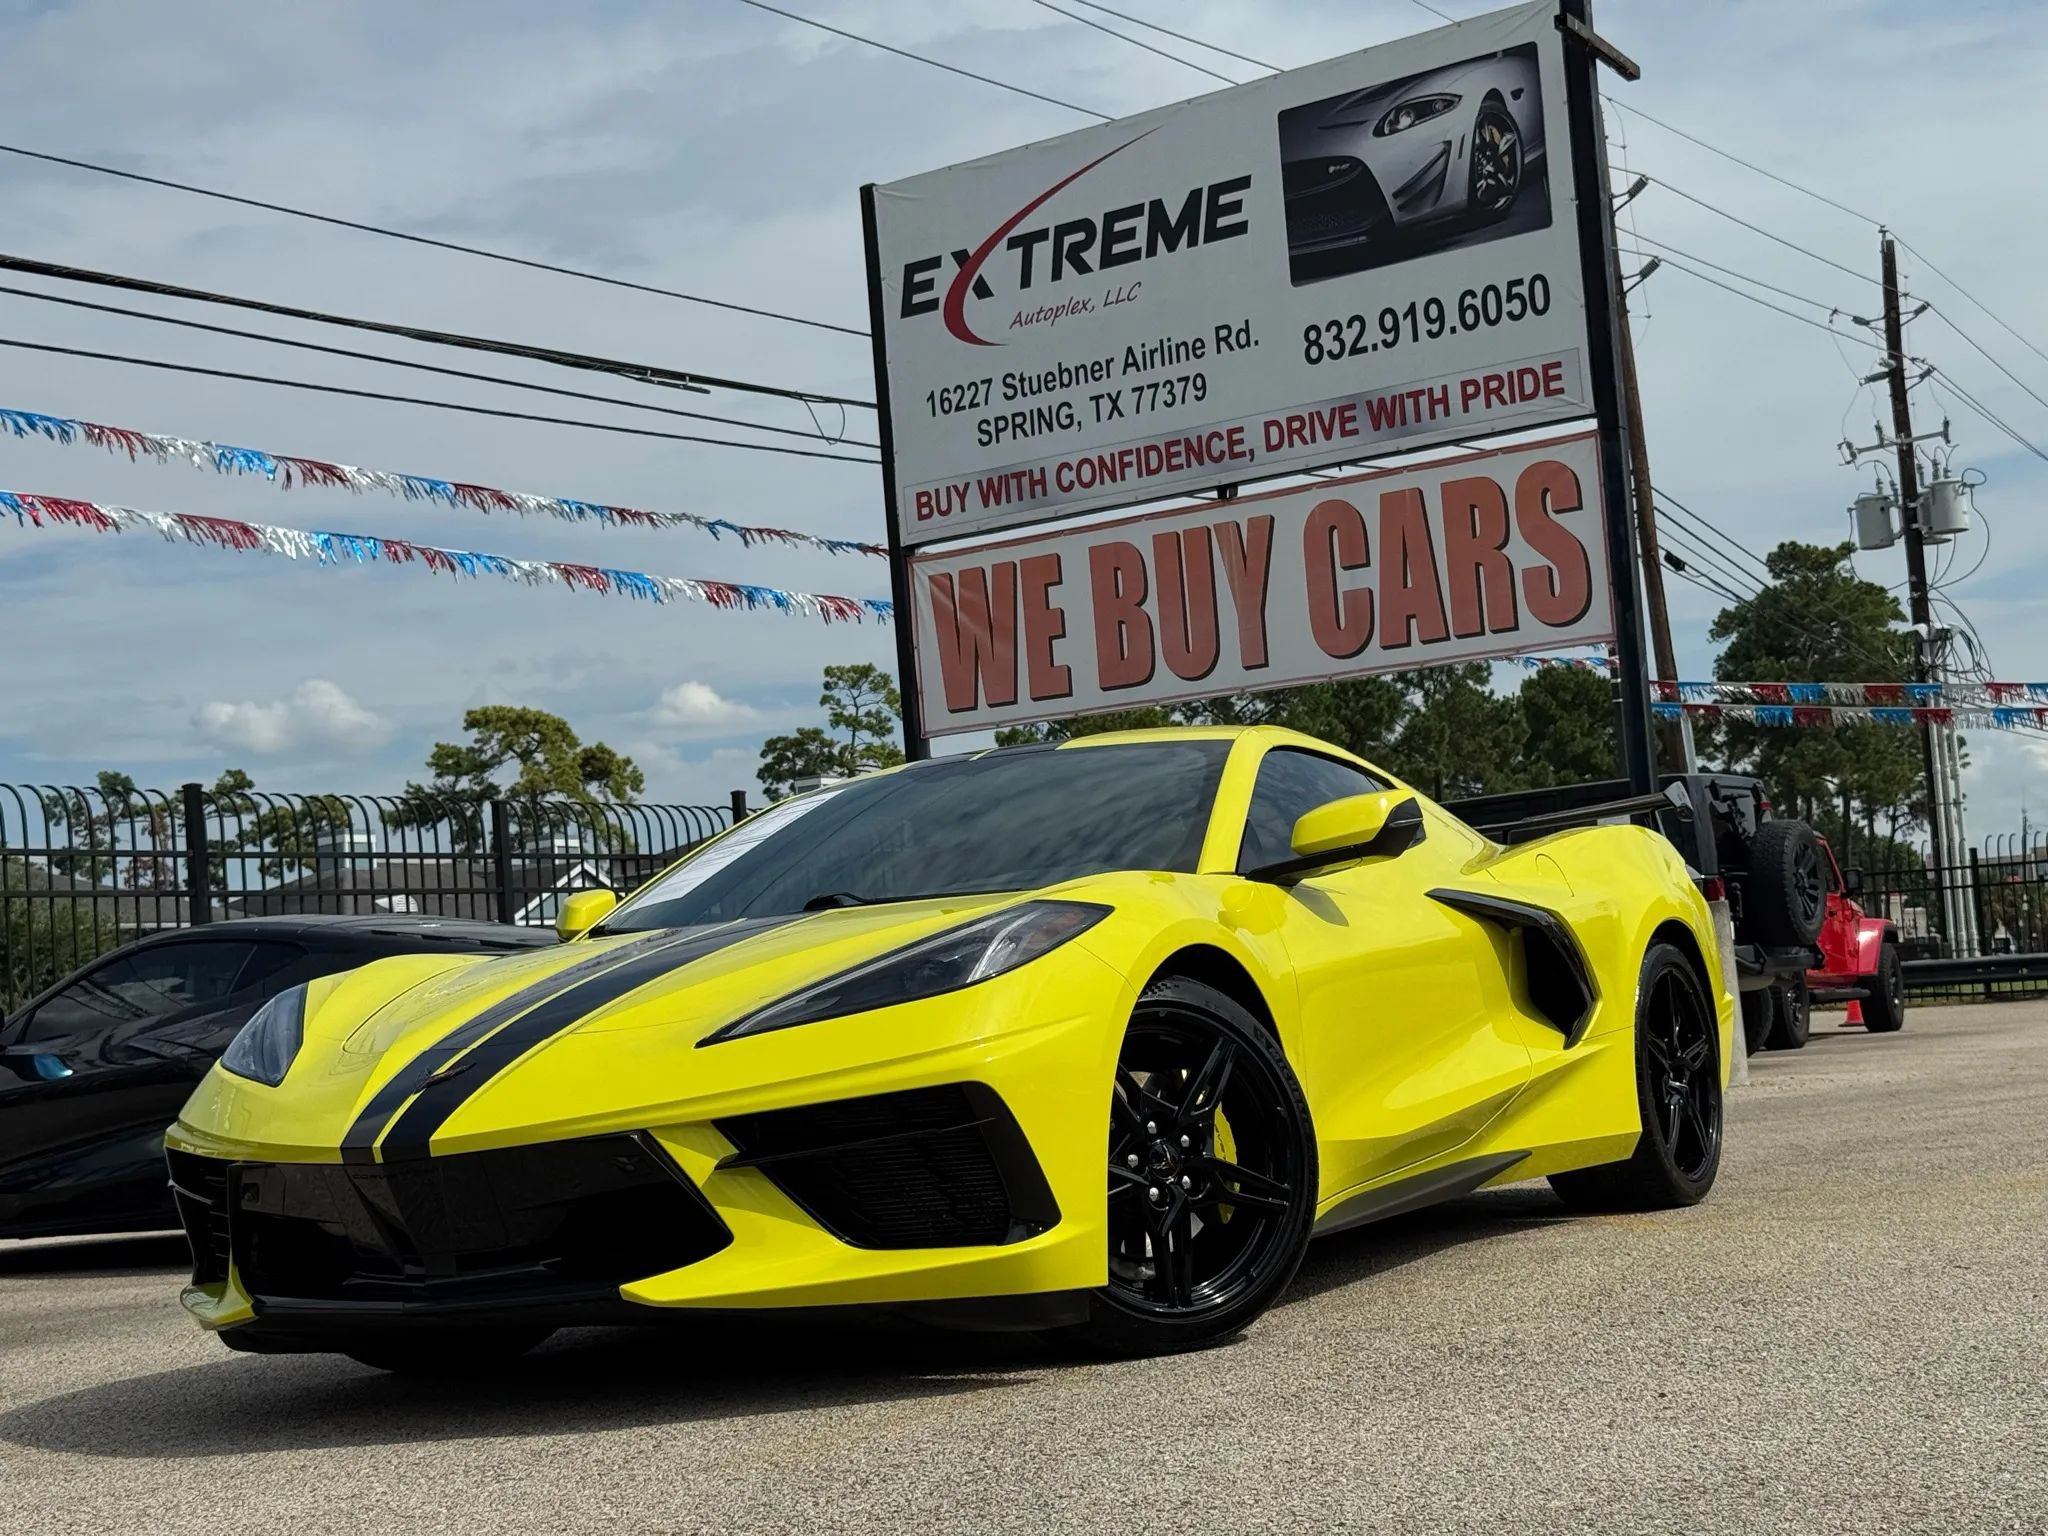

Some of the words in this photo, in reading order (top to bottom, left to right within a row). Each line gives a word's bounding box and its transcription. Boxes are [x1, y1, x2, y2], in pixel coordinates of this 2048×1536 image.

[900, 174, 1252, 319] EXTREME
[1009, 296, 1096, 330] Autoplex,
[1103, 281, 1142, 308] LLC
[1303, 273, 1551, 365] 832.919.6050
[926, 378, 994, 417] 16227
[1001, 356, 1115, 400] Stuebner
[1122, 335, 1206, 376] Airline
[1214, 319, 1260, 355] Rd.
[977, 401, 1083, 447] SPRING,
[1089, 392, 1125, 423] TX
[1131, 372, 1207, 416] 77379
[915, 481, 971, 521] BUY
[977, 466, 1048, 508] WITH
[1055, 426, 1256, 493] CONFIDENCE,
[1263, 403, 1360, 453] DRIVE
[1366, 384, 1450, 432] WITH
[1459, 361, 1566, 414] PRIDE
[927, 552, 1073, 714] WE
[1088, 514, 1275, 692] BUY
[1303, 460, 1593, 660] CARS
